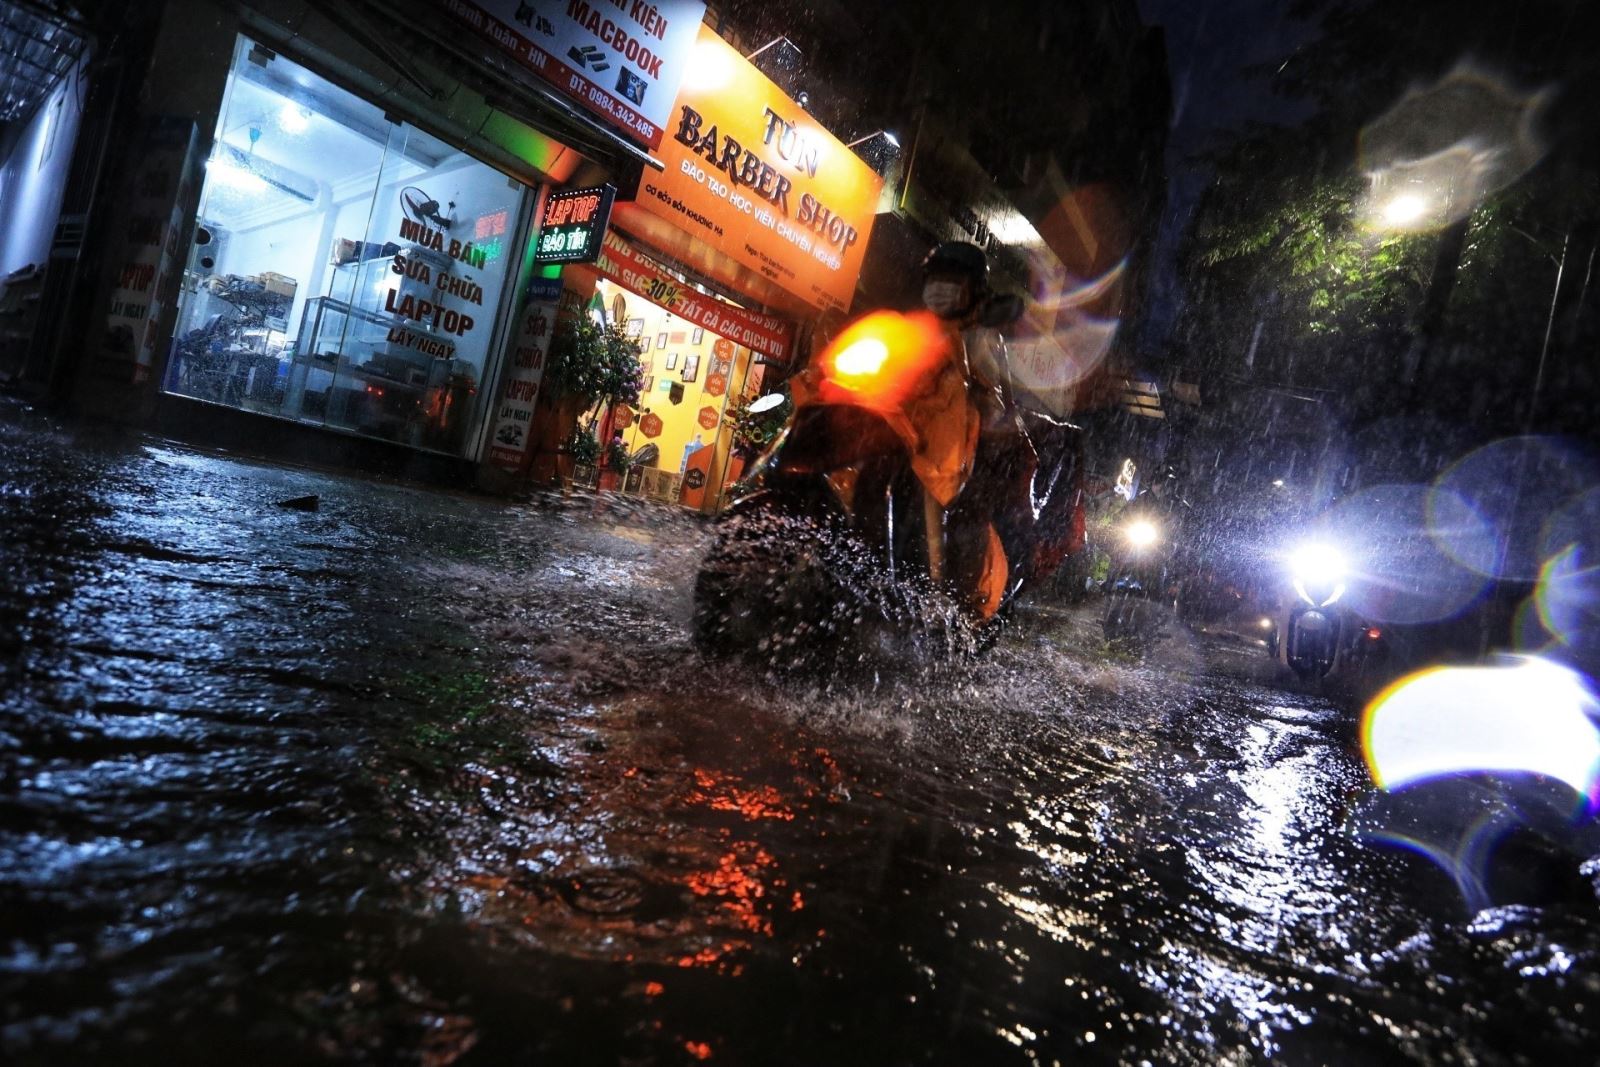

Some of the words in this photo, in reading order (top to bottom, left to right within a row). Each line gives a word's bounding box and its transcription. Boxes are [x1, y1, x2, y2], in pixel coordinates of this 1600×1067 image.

[484, 20, 518, 51] Xuân
[527, 49, 547, 69] HN
[566, 0, 664, 80] MACBOOK
[630, 0, 668, 41] KIỆN
[589, 88, 654, 139] 0984.342.485
[674, 105, 792, 218] BARBER
[796, 192, 858, 256] SHOP
[681, 160, 706, 183] ĐÀO
[708, 176, 728, 198] TẠO
[729, 191, 752, 214] HỌC
[754, 206, 776, 230] VIÊN
[546, 195, 598, 226] LAPTOP
[399, 217, 444, 252] MUA
[449, 239, 486, 270] BÁN
[542, 227, 566, 252] BẢO
[566, 227, 587, 251] TÍN
[391, 252, 431, 285] SỬA
[437, 272, 483, 306] CHỮA
[385, 288, 474, 337] LAPTOP
[647, 277, 678, 307] 30%
[679, 298, 701, 320] TẤT
[702, 311, 721, 329] CẢ
[720, 320, 743, 339] CÁC
[769, 340, 784, 358] VỤ
[417, 338, 456, 360] NGAY
